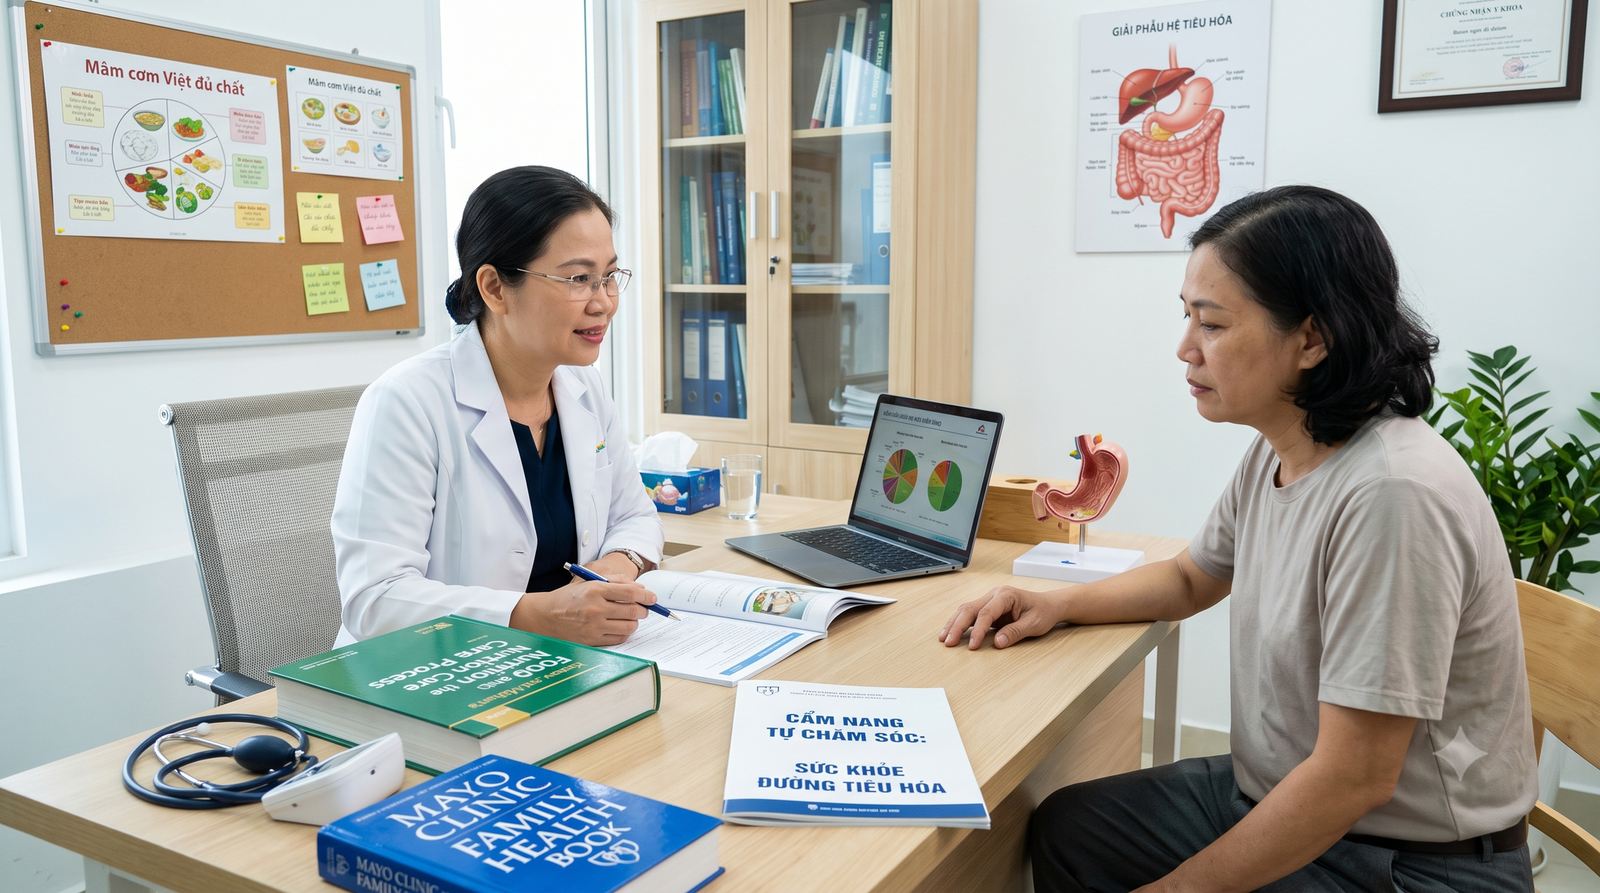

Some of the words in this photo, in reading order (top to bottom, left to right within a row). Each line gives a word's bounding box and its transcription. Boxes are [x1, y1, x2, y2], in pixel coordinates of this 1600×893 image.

[1112, 23, 1132, 36] GIẢI
[1166, 19, 1180, 32] HỆ
[1183, 16, 1206, 29] TIÊU
[1209, 14, 1232, 26] HÓA
[86, 59, 124, 78] Mâm
[128, 69, 160, 84] cơm
[163, 71, 192, 91] Việt
[196, 76, 212, 91] đủ
[216, 80, 245, 96] chất
[368, 658, 458, 688] Process
[430, 684, 460, 696] the
[766, 727, 796, 740] TỰ
[802, 728, 867, 742] CHĂM
[874, 731, 926, 743] SÓC:
[786, 710, 835, 726] CẨM
[842, 716, 904, 728] NANG
[795, 760, 838, 774] SỨC
[846, 762, 905, 776] KHỎE
[385, 770, 510, 829] MAYO
[758, 776, 836, 792] ĐƯỜNG
[843, 779, 892, 793] TIÊU
[900, 780, 946, 794] HÓA
[415, 776, 552, 842] CLINIC
[450, 788, 588, 860] FAMILY
[482, 798, 628, 874] HEALTH
[544, 822, 632, 868] BOOK
[356, 856, 393, 881] MAYO
[394, 871, 439, 893] CLINIC
